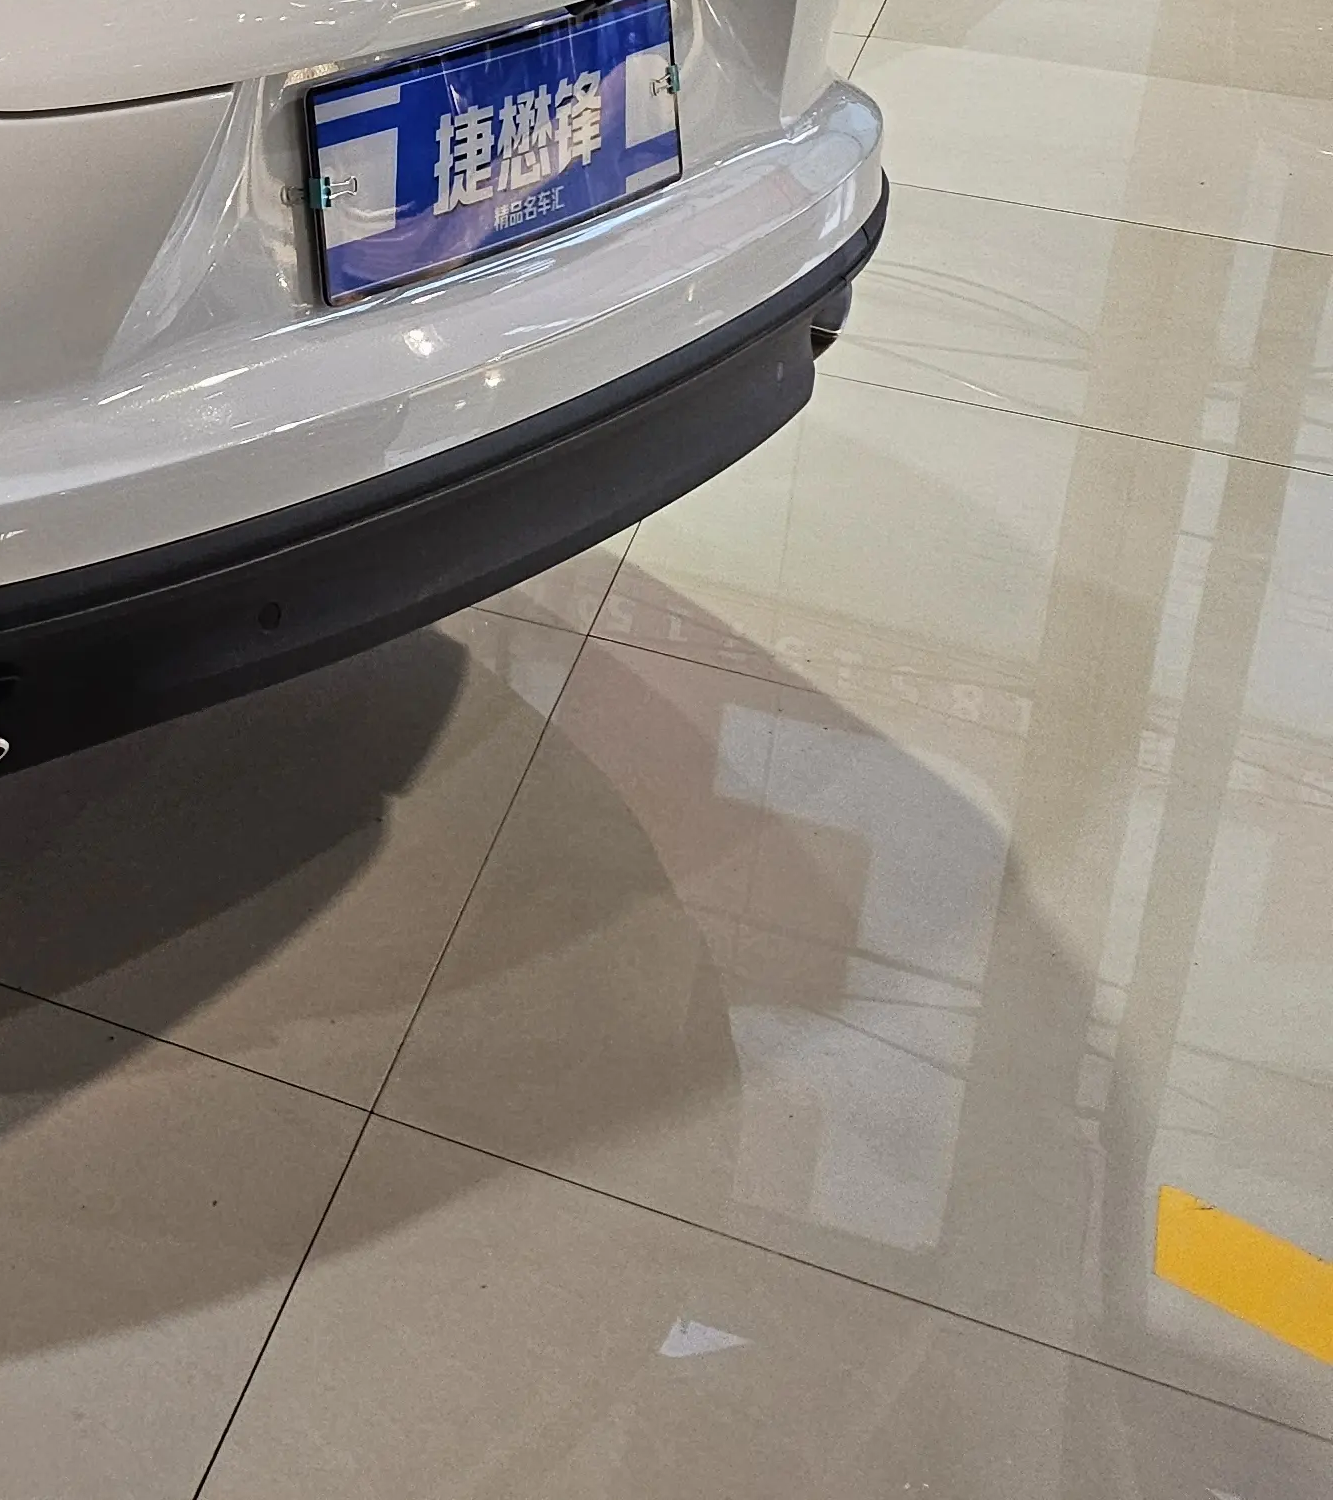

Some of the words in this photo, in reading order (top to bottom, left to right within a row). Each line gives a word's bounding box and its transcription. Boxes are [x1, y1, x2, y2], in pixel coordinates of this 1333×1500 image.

[433, 70, 602, 216] 捷懋锋
[493, 185, 565, 232] 精品名车汇
